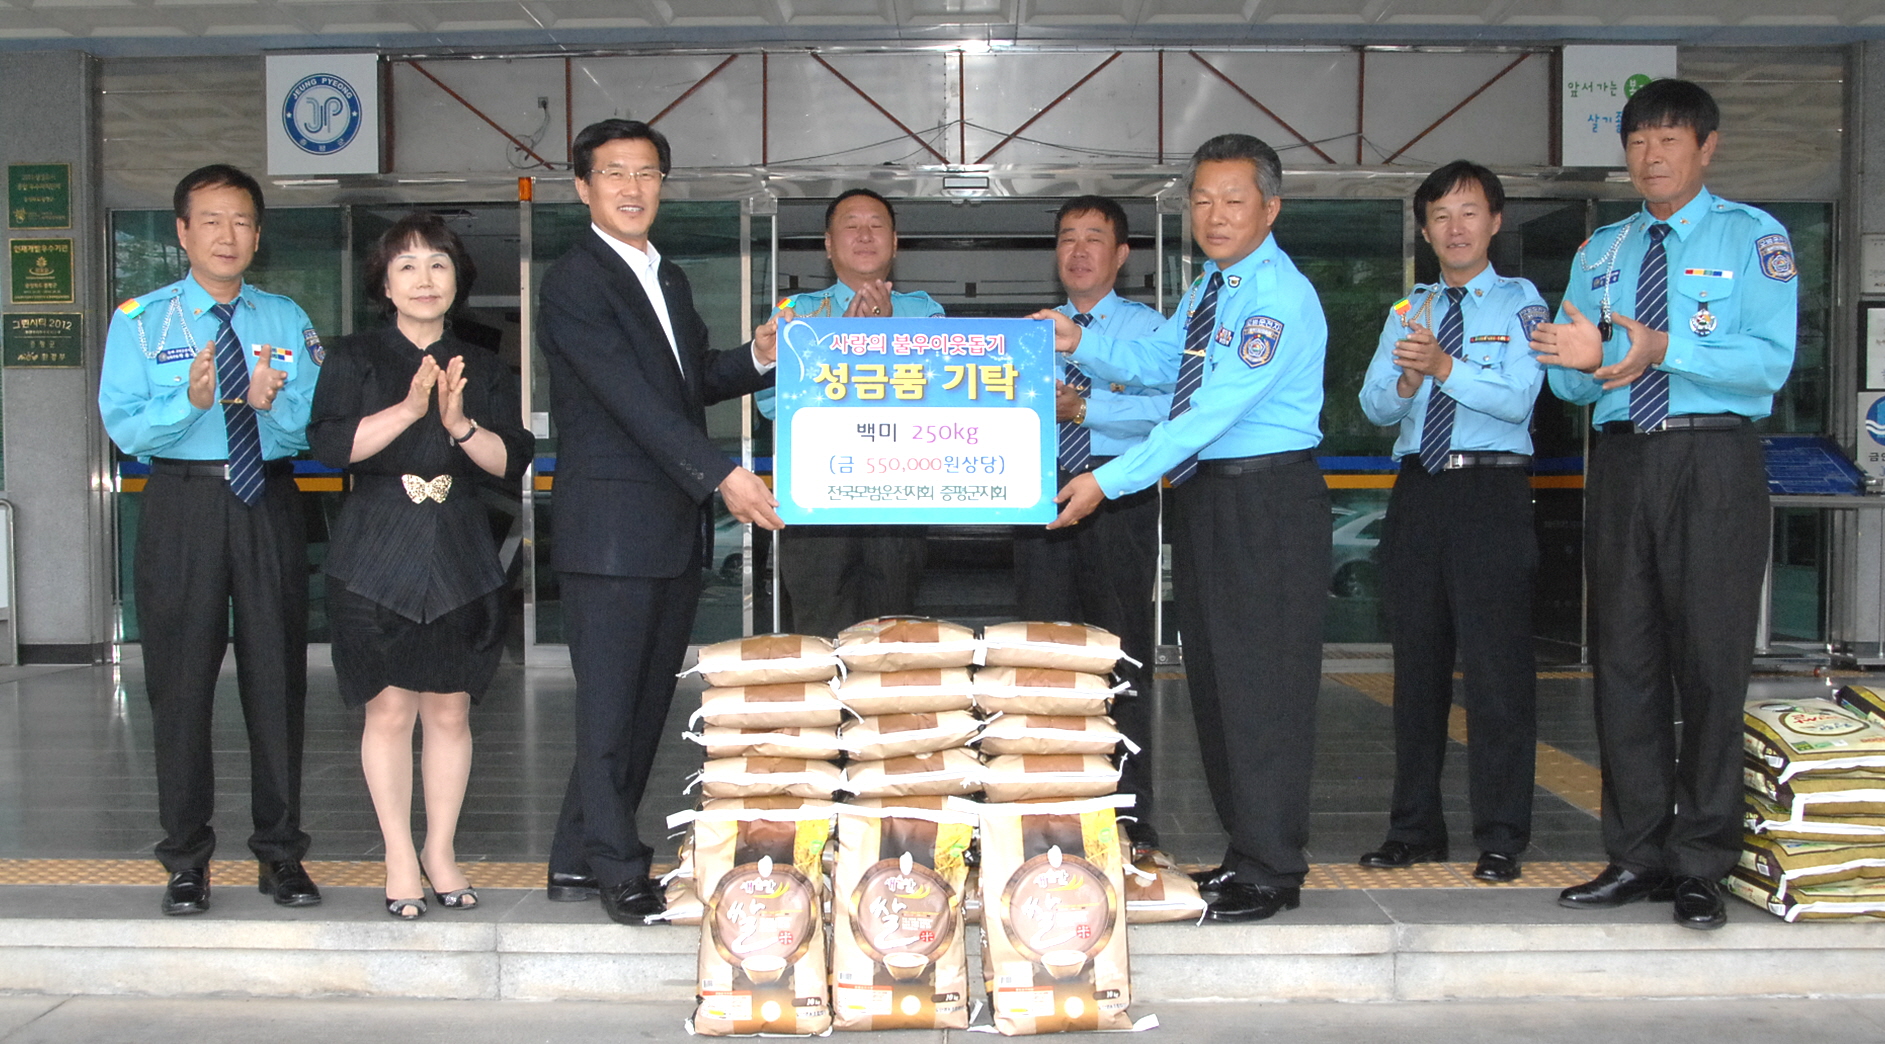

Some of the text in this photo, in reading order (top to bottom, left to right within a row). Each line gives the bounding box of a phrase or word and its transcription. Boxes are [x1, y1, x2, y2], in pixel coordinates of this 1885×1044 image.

[292, 77, 353, 100] JEUNG PYEONG
[1568, 81, 1617, 97] 앞서가는
[12, 318, 72, 330] 그린시티 2012
[830, 334, 1006, 355] 사랑의 불우이웃돕기
[813, 363, 1019, 401] 성금품 기탁
[856, 422, 979, 445] 백미 250kg
[829, 455, 1005, 475] (금 550,000원상당)
[940, 485, 1007, 502] 증평군지회
[869, 896, 920, 949] 쌀
